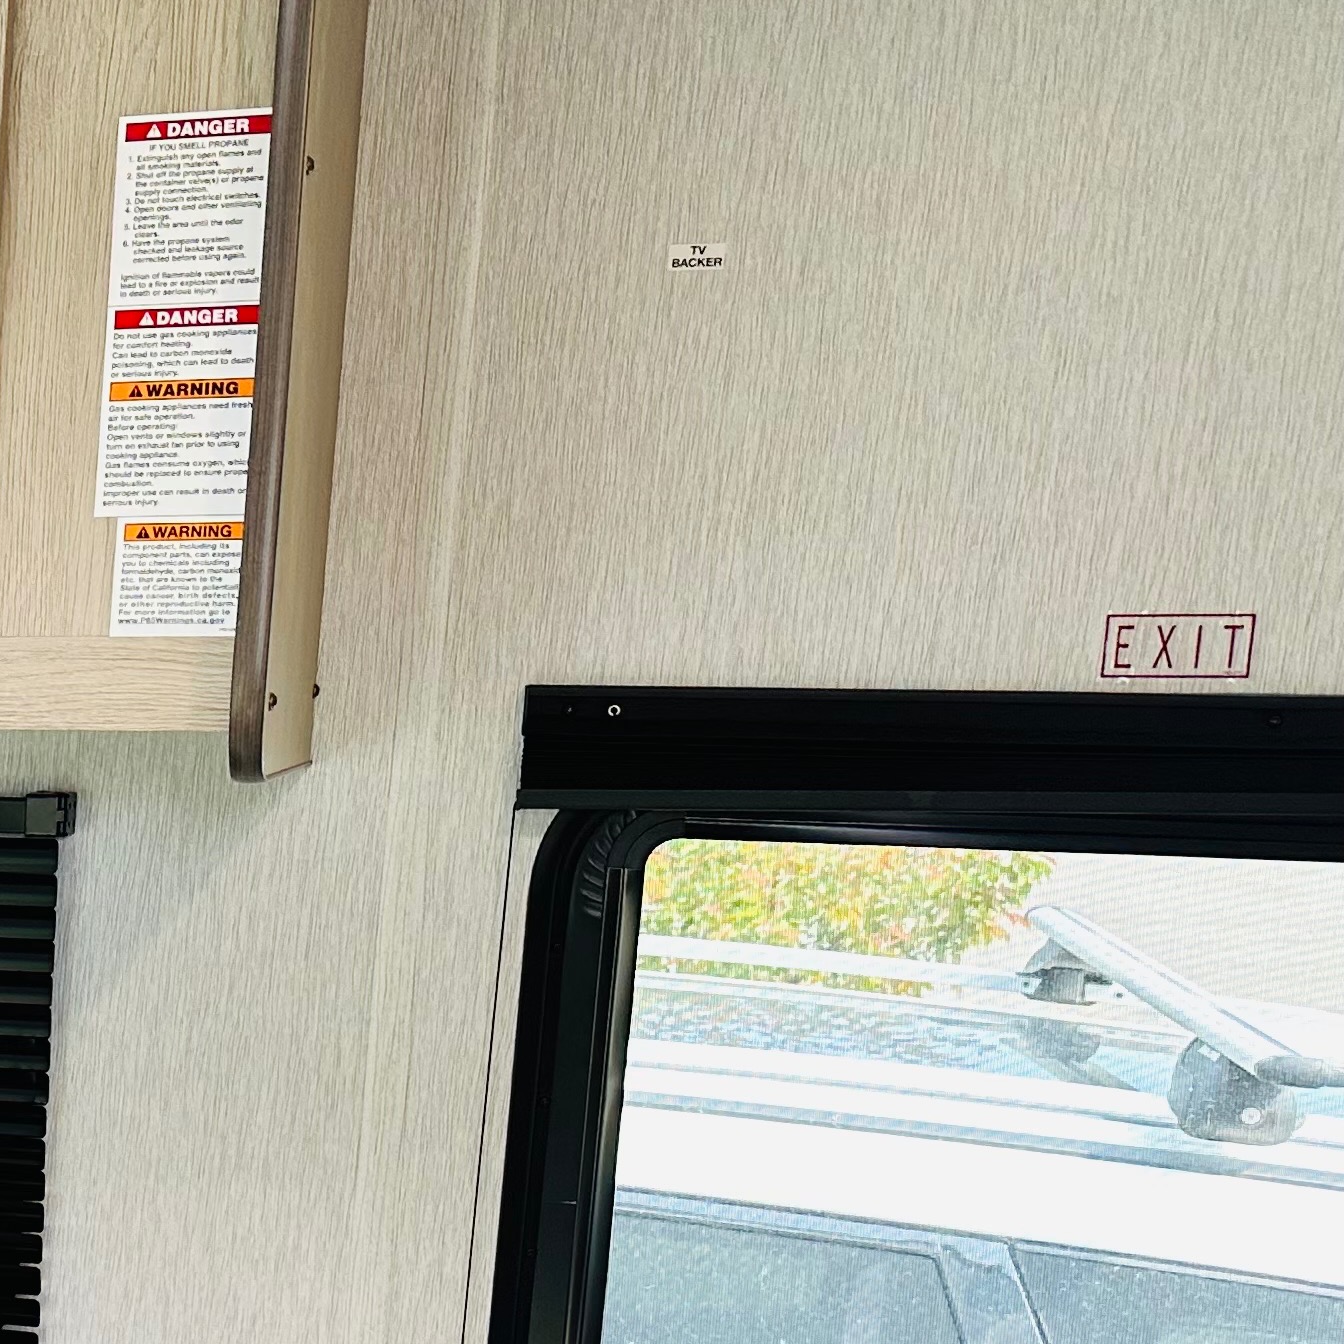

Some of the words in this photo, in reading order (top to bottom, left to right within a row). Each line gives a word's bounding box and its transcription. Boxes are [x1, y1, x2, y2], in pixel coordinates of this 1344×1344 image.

[166, 118, 250, 136] DANGER
[690, 246, 707, 255] TV
[672, 257, 722, 268] BACKER
[156, 308, 238, 325] DANGER
[146, 381, 239, 397] WARNING
[152, 525, 232, 538] WARNING
[1114, 624, 1244, 668] EXIT
